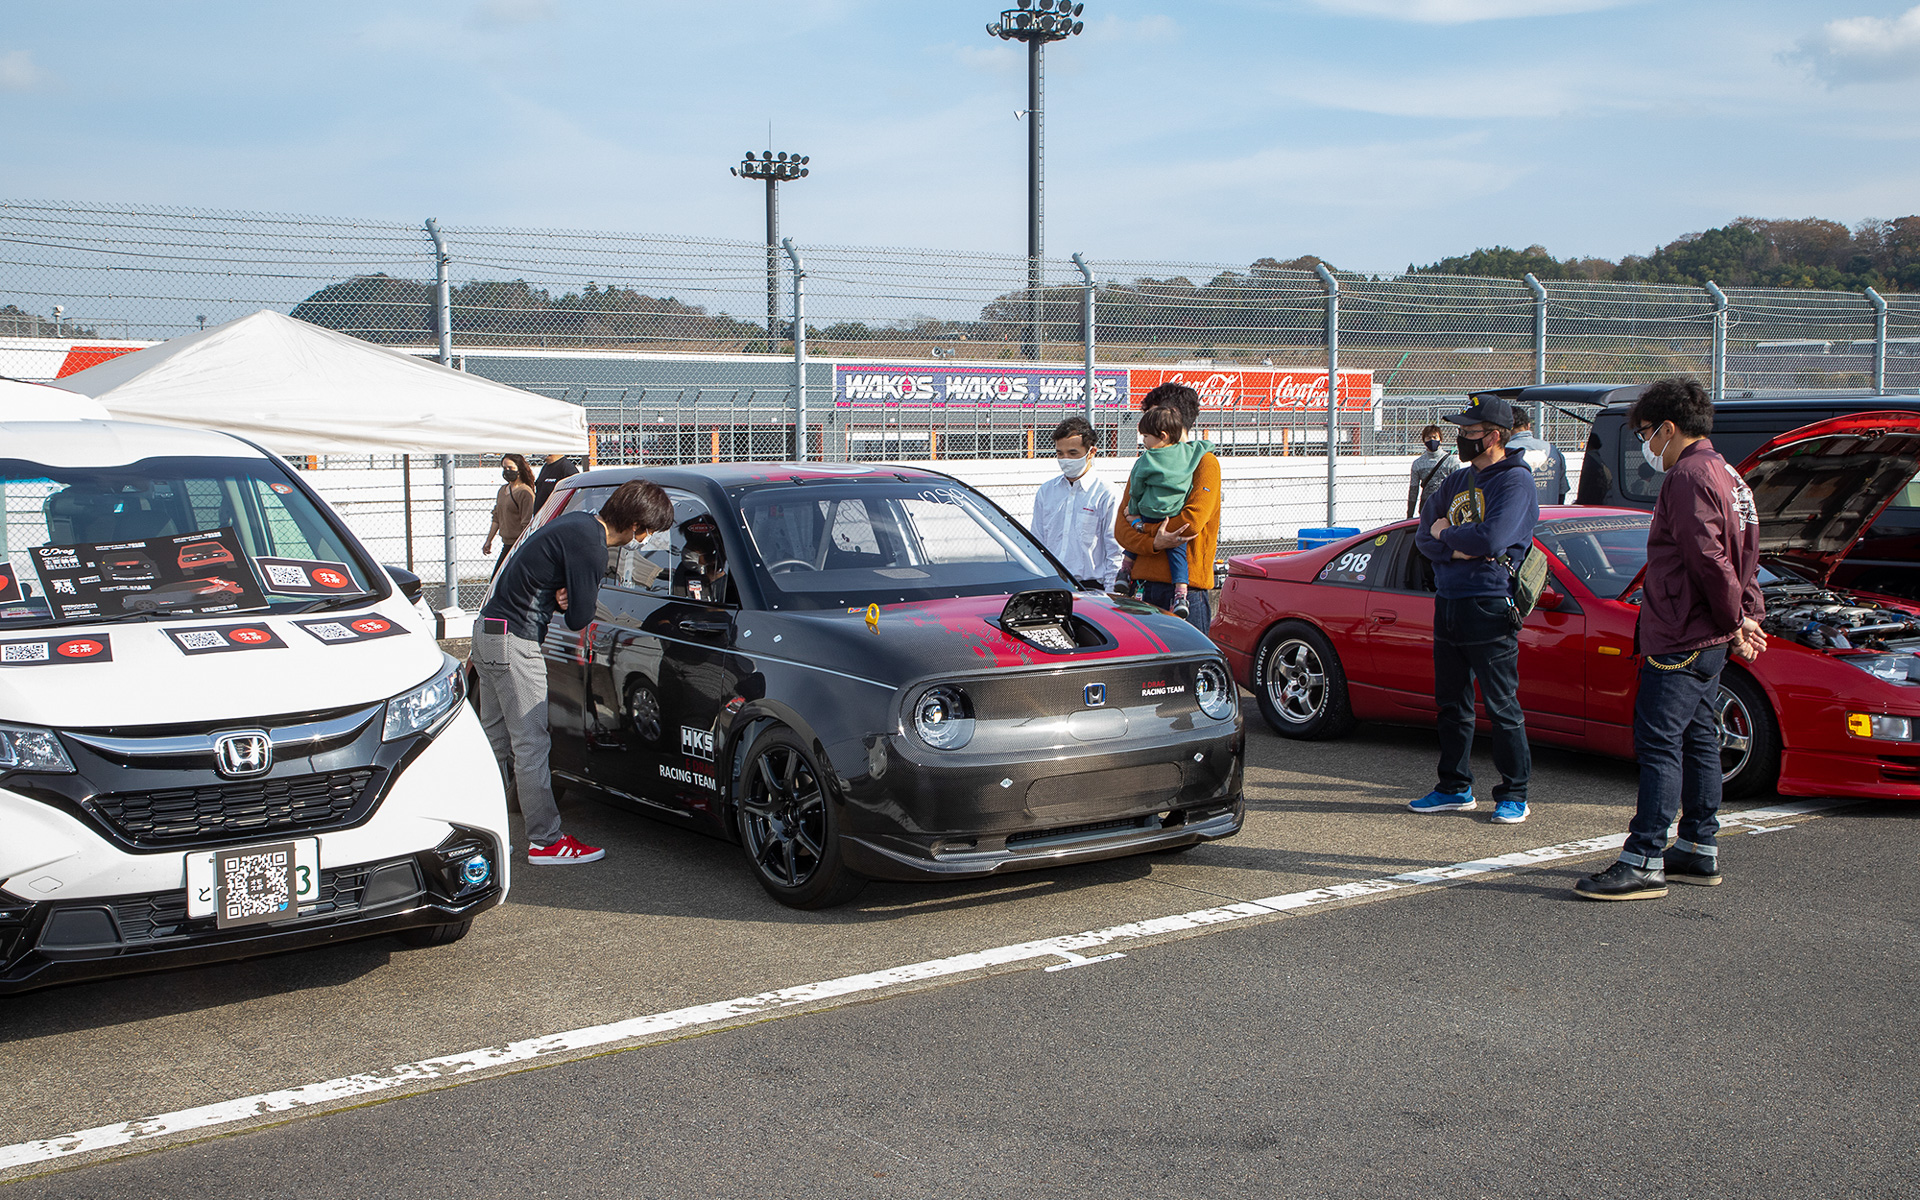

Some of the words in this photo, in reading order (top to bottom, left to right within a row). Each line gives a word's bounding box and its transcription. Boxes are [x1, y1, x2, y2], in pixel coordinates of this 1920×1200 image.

[1336, 552, 1372, 573] 918
[56, 586, 76, 594] 700
[1141, 687, 1167, 697] RACING
[1167, 685, 1185, 694] TEAM
[1147, 680, 1166, 688] DRAG
[681, 729, 714, 753] HKS
[685, 758, 691, 770] E
[692, 759, 715, 777] DRAG
[659, 764, 692, 784] RACING
[692, 773, 717, 791] TEAM
[295, 865, 312, 896] 3
[198, 886, 212, 903] と
